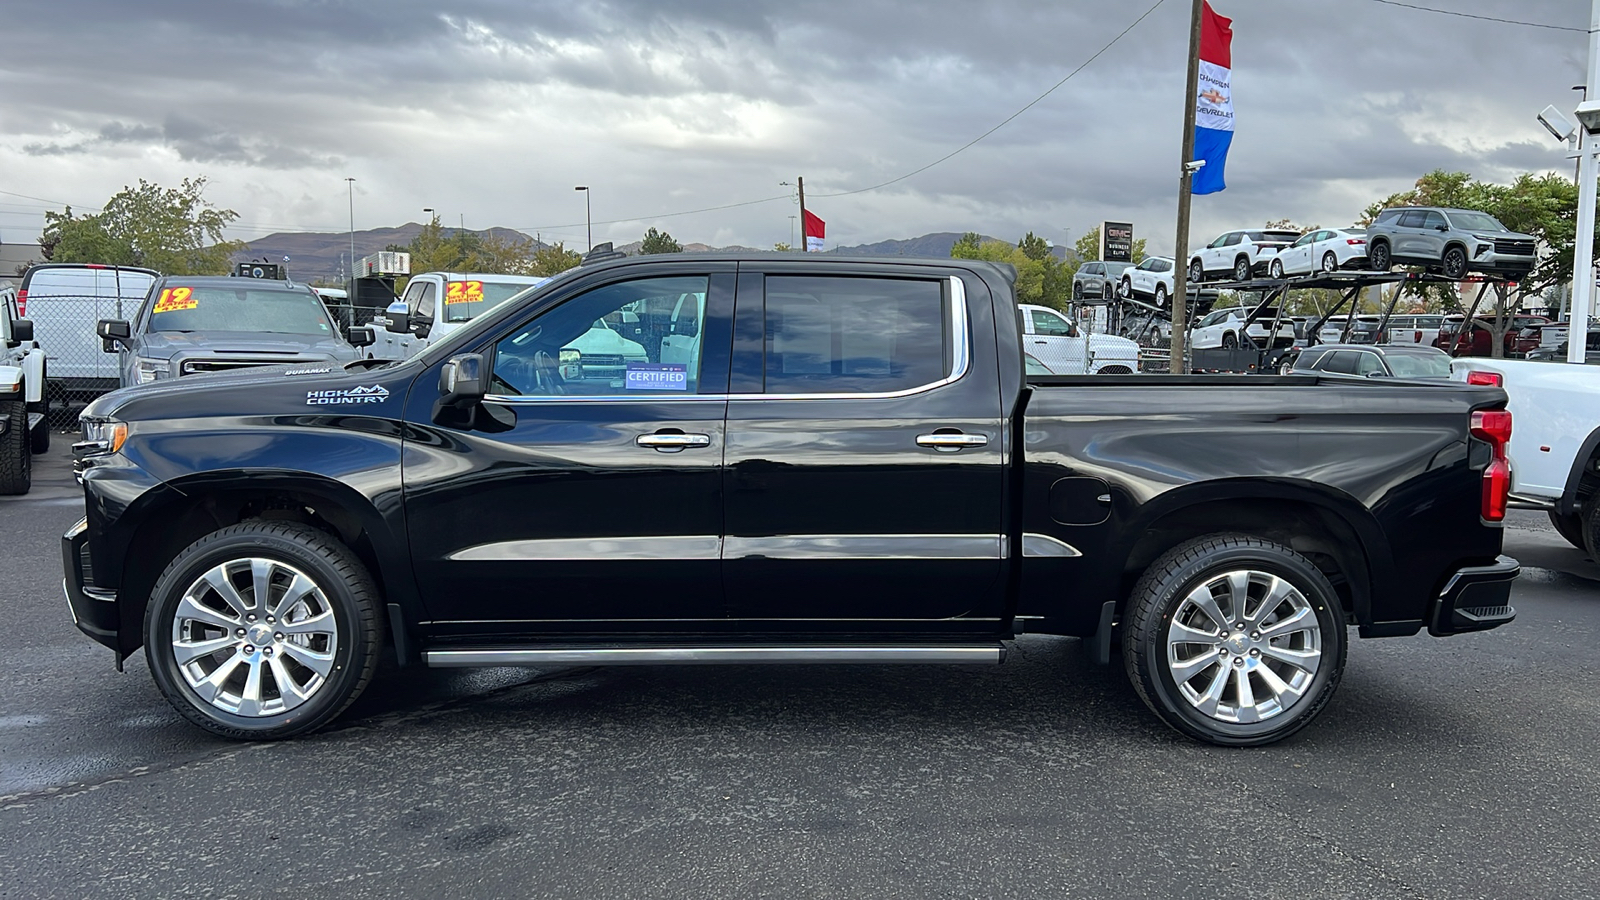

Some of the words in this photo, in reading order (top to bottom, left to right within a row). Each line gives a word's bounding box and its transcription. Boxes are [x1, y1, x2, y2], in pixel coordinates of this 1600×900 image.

[1108, 229, 1131, 238] GMC
[448, 281, 481, 296] 22
[159, 287, 191, 304] 19
[284, 367, 332, 376] DURAMAX
[628, 372, 684, 382] CERTIFIED
[307, 389, 349, 398] HIGH
[306, 396, 389, 405] COUNTRY
